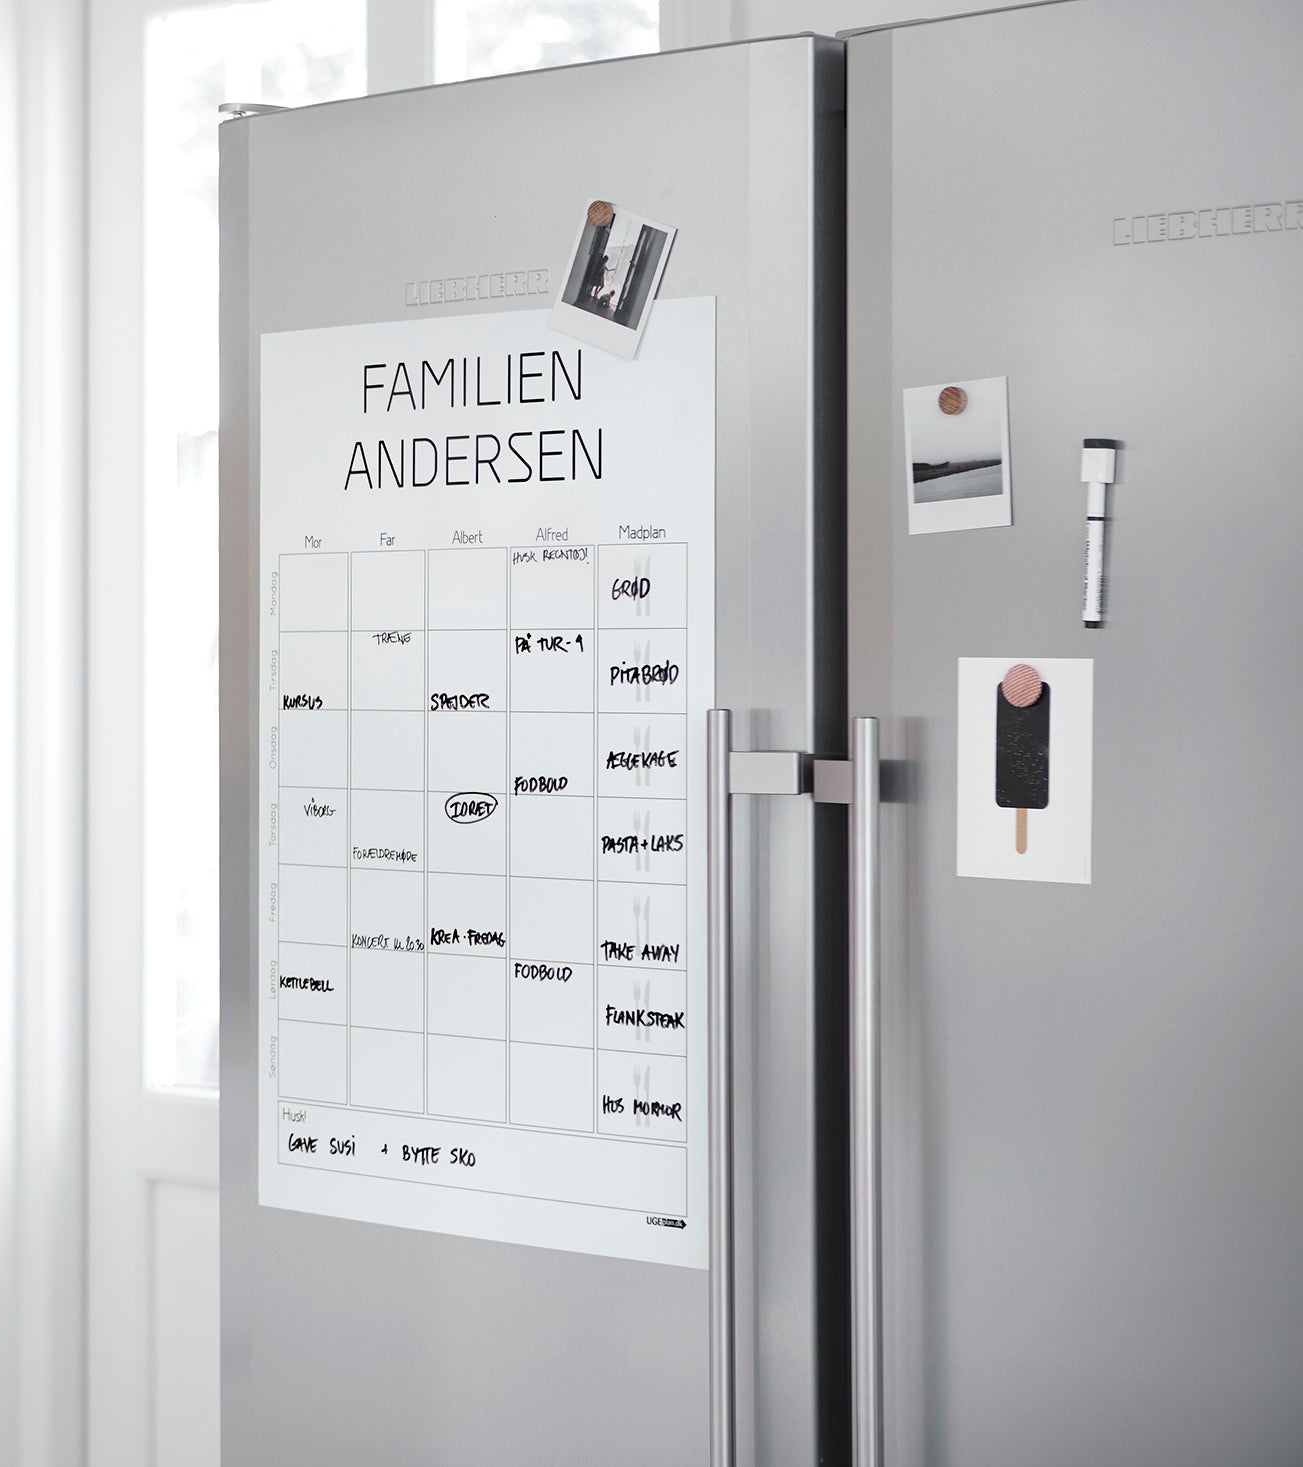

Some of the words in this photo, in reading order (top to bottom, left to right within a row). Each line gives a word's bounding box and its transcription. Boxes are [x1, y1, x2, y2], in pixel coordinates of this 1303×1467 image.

[1113, 201, 1303, 246] LIEBHERR
[405, 269, 550, 306] LIEBHERR
[364, 350, 581, 413] FAMILIEN
[345, 428, 602, 490] ANDERSEN
[305, 536, 322, 548] Mor
[380, 533, 395, 546] Far
[452, 530, 483, 544] Albert
[536, 528, 568, 541] Alfred
[619, 525, 665, 541] Madplan
[513, 551, 537, 565] HUSK
[269, 571, 278, 616] Mandag
[515, 633, 531, 654] PÅ
[269, 650, 278, 691] Tirsdag
[283, 694, 322, 710] KURSUS
[431, 693, 490, 711] SPEJDER
[269, 726, 277, 769] Onsdag
[514, 776, 568, 796] FODBOLD
[269, 803, 277, 846] Torsdag
[601, 836, 639, 854] PASTA
[651, 834, 683, 852] LAKS
[269, 883, 277, 922] Fredag
[431, 928, 460, 945] KREA
[601, 940, 635, 961] TAKE
[641, 944, 679, 962] AWAY
[515, 963, 572, 982] FODBOLD
[606, 1004, 685, 1029] FLANKSTEAK
[269, 1036, 277, 1078] Søndag
[603, 1095, 624, 1114] HUS
[283, 1108, 306, 1122] Husk!
[289, 1133, 318, 1153] GAVE
[402, 1145, 441, 1165] BYTTE
[450, 1148, 475, 1166] SKO
